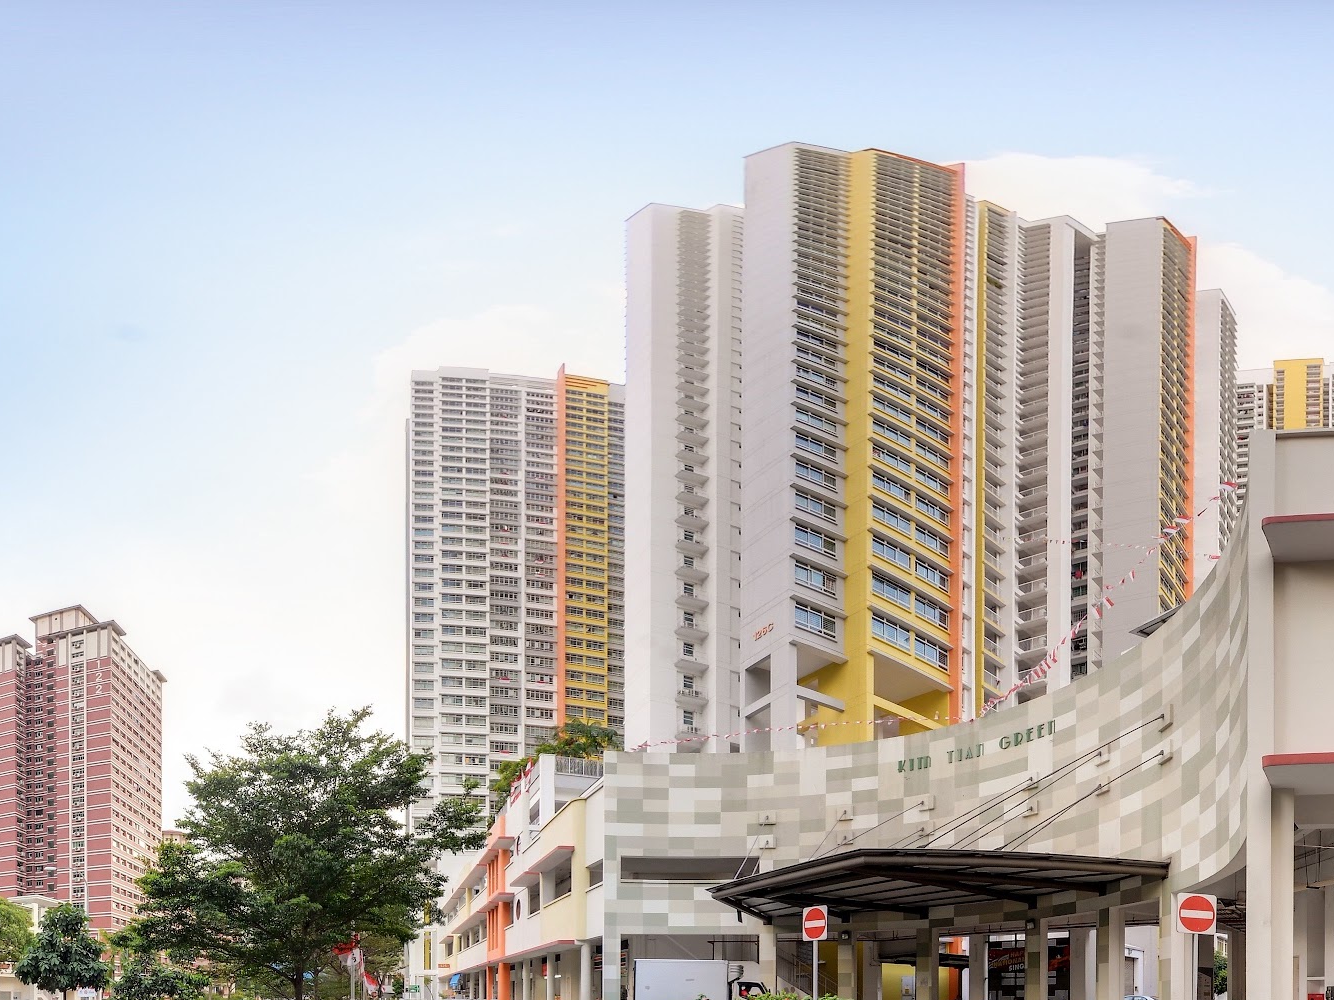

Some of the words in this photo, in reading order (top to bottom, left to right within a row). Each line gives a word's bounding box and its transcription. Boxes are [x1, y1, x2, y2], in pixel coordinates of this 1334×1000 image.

[95, 659, 103, 695] 122
[897, 755, 932, 773] KIM
[946, 743, 985, 764] TIAN
[998, 719, 1056, 750] GREEN
